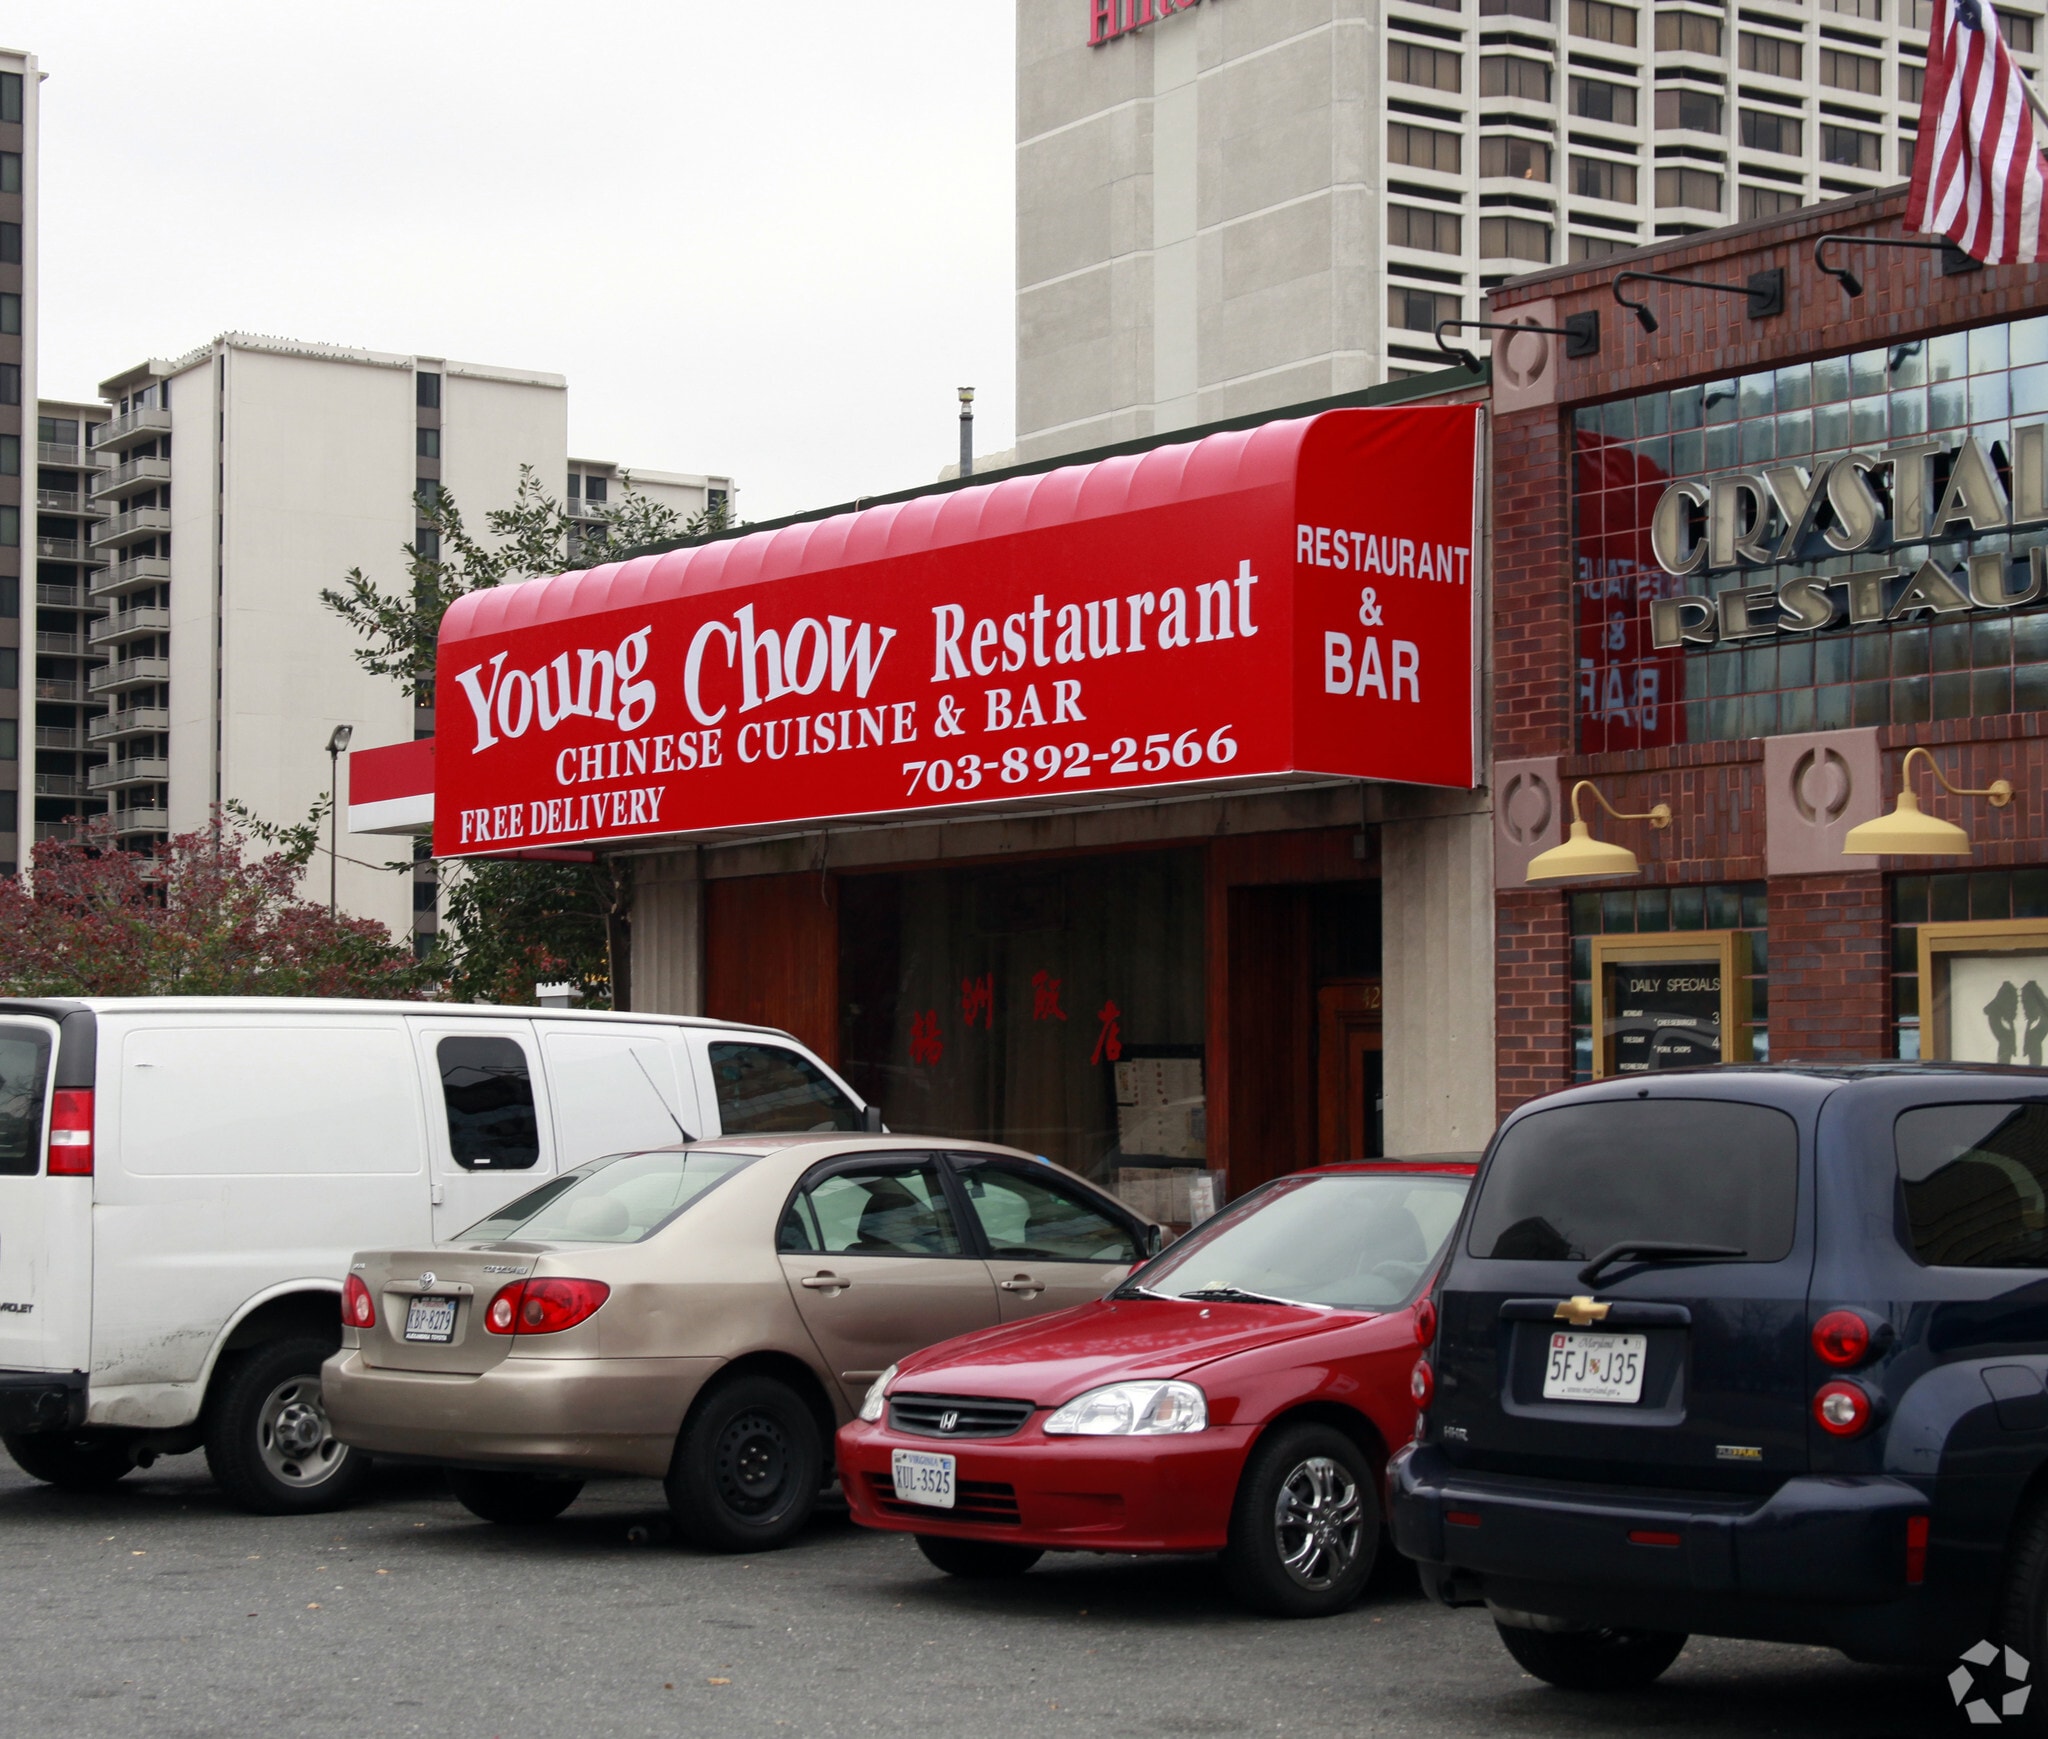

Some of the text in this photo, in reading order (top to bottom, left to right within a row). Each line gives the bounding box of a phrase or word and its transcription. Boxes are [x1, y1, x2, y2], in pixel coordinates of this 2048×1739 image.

[1296, 523, 1470, 586] RESTAURANT
[1358, 586, 1384, 627] &
[1650, 546, 2048, 650] RESTAU
[455, 625, 656, 755] Young
[930, 559, 1259, 683] Restaurant
[1324, 630, 1421, 703] BAR
[555, 679, 1087, 786] CHINESE CUISINE & BAR
[902, 724, 1238, 797] 703-892-2566
[459, 786, 666, 845] FREE DELIVERY
[1630, 977, 1720, 993] DAILY SPECIALS
[895, 1465, 951, 1494] XUL-3525
